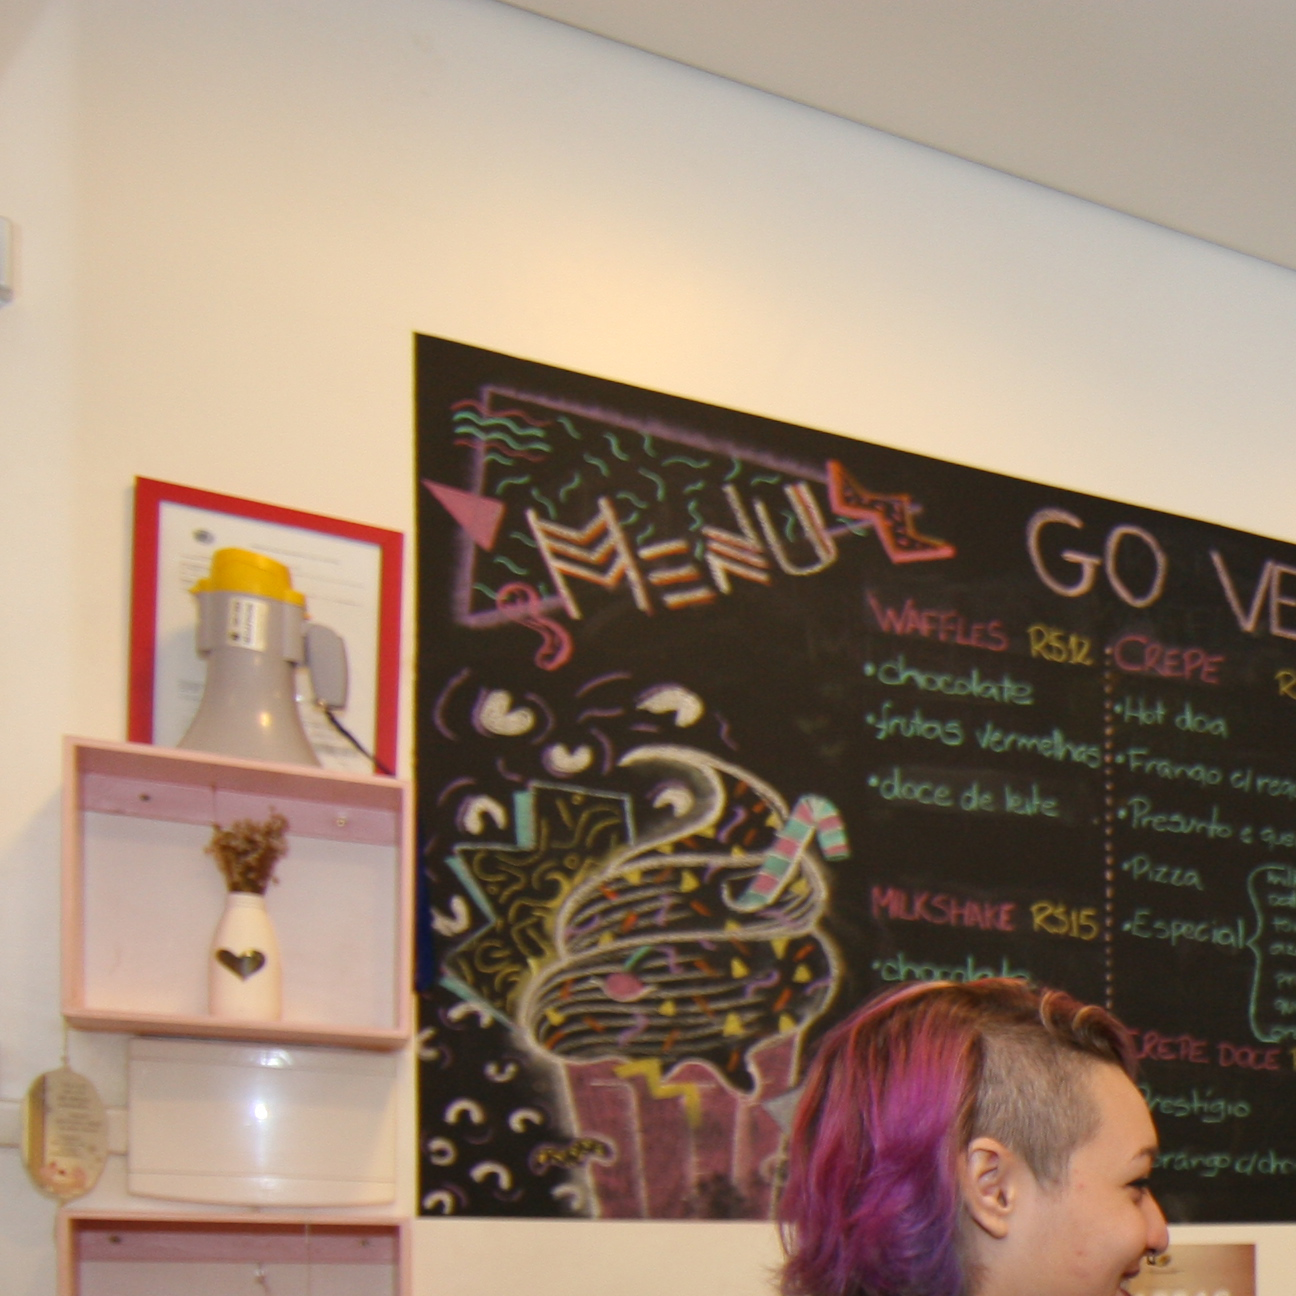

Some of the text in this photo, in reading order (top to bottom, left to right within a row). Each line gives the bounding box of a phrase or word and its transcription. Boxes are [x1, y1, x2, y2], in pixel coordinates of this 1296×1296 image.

[525, 480, 838, 621] MENU
[1026, 507, 1167, 609] GO
[866, 591, 1094, 666] WAFFLES R$12
[877, 653, 1035, 705] chocolate
[1114, 634, 1226, 685] CREPE
[874, 699, 1101, 769] frutas vermelhas
[1123, 695, 1168, 726] Hot
[880, 767, 1060, 818] doce de leite
[1127, 746, 1224, 789] Frango
[1127, 795, 1233, 840] Presunto
[1239, 825, 1253, 845] e
[1131, 853, 1205, 892] Pizza
[870, 884, 1099, 942] MILKSHAKE R$15
[1131, 907, 1245, 950] Especial
[1217, 1040, 1282, 1071] DOCE
[1152, 1151, 1232, 1179] orango
